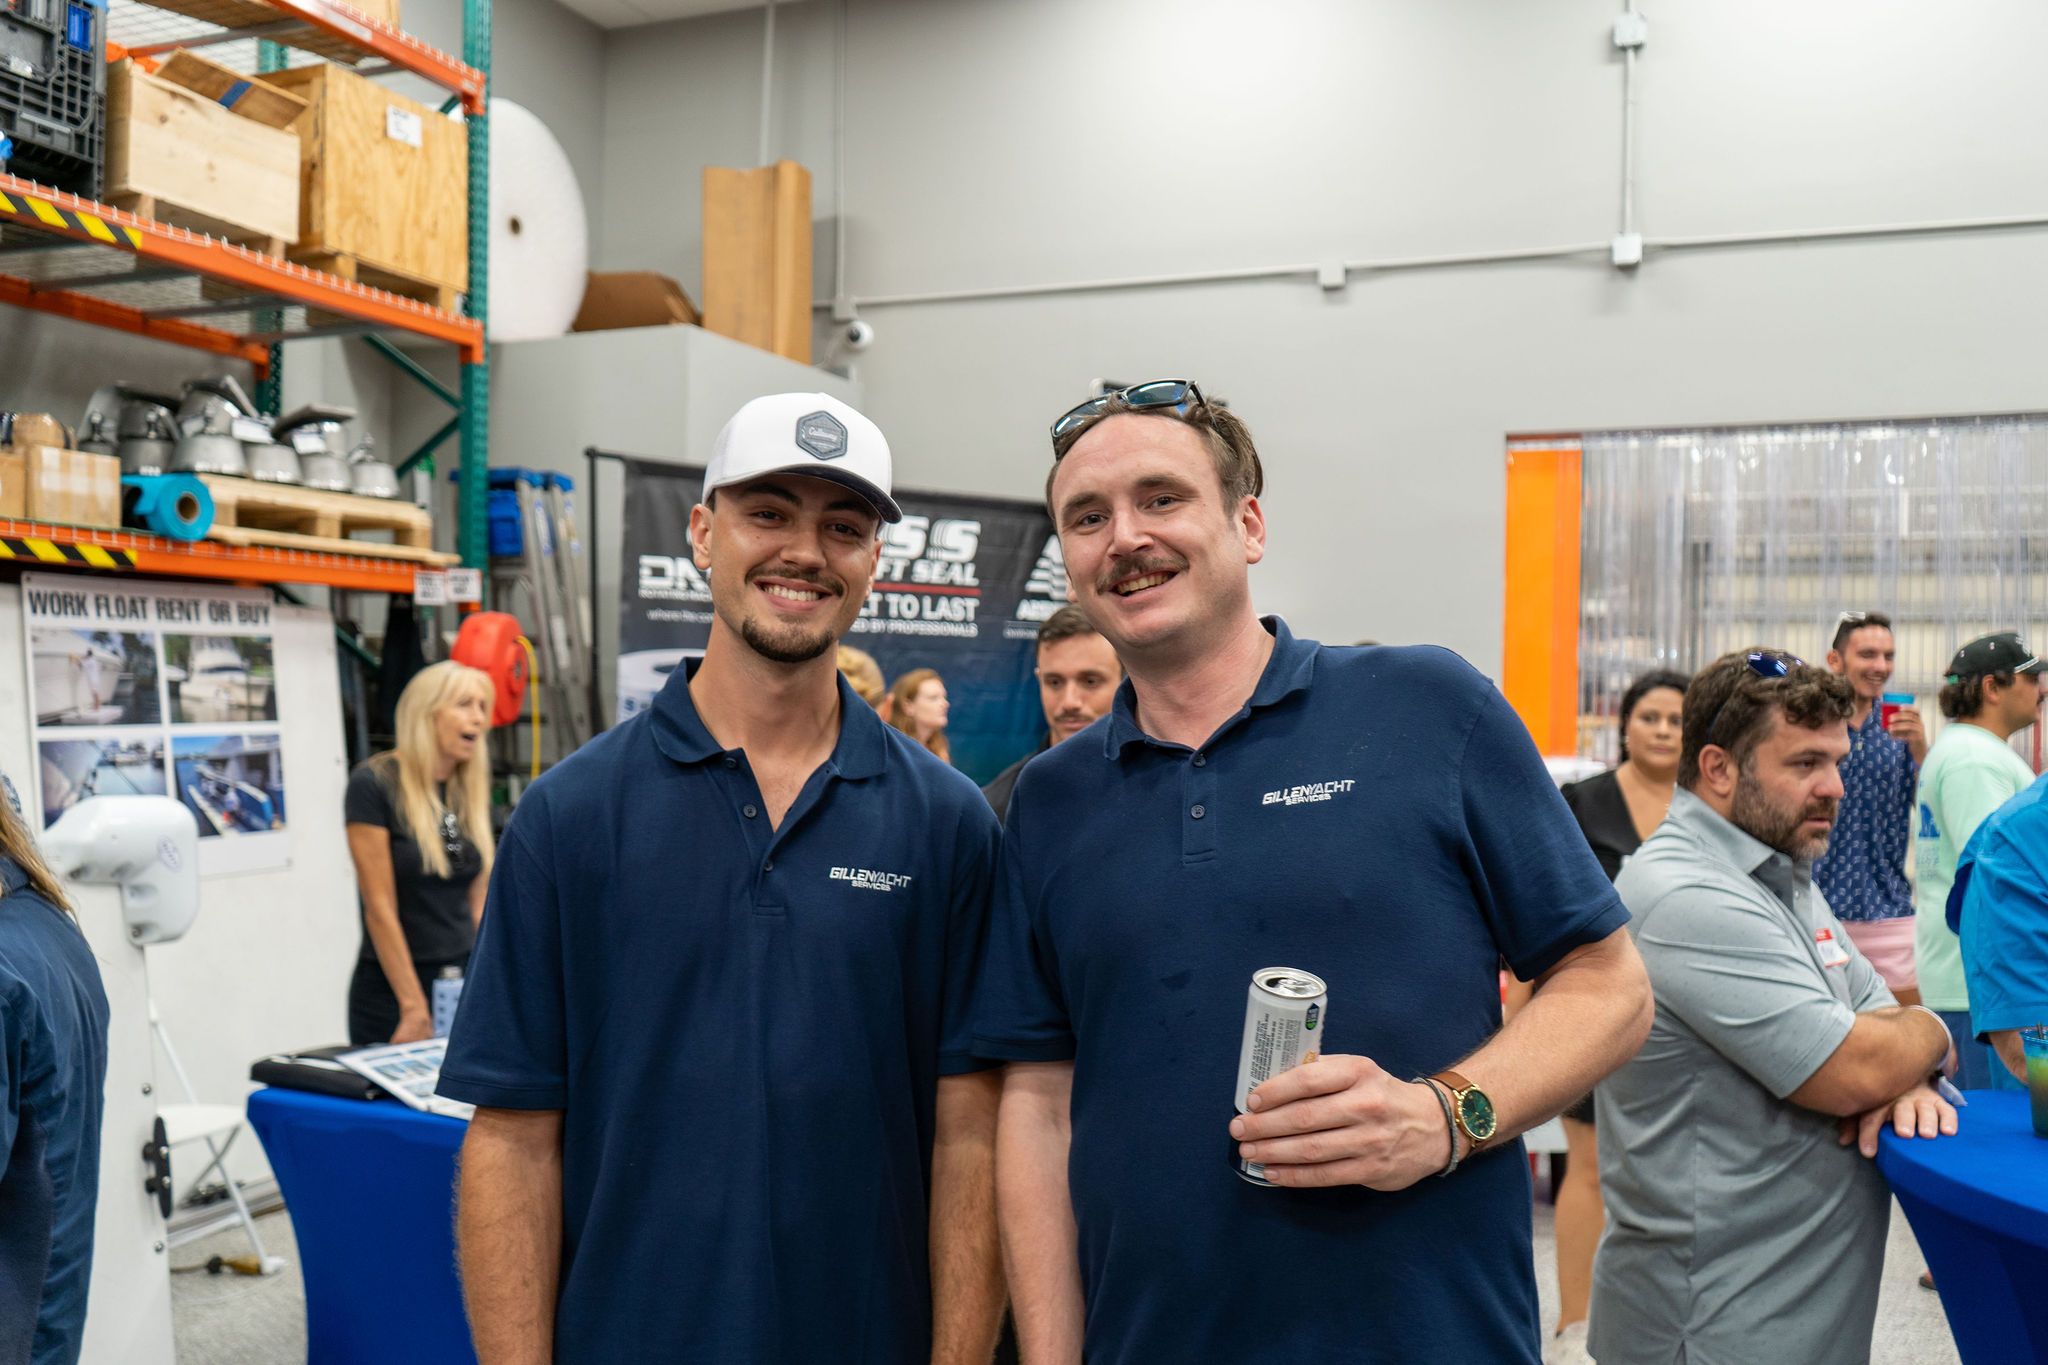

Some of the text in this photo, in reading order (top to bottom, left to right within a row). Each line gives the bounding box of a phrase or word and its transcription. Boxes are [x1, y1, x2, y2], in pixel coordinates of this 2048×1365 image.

[911, 559, 980, 586] SEAL
[28, 589, 271, 625] WORK FLOAT RENT OR BUY
[885, 593, 920, 619] TO
[922, 595, 980, 622] LAST
[887, 620, 979, 638] PROFESSIONALS
[1285, 793, 1331, 805] SERVICES
[851, 880, 891, 891] SERVICES
